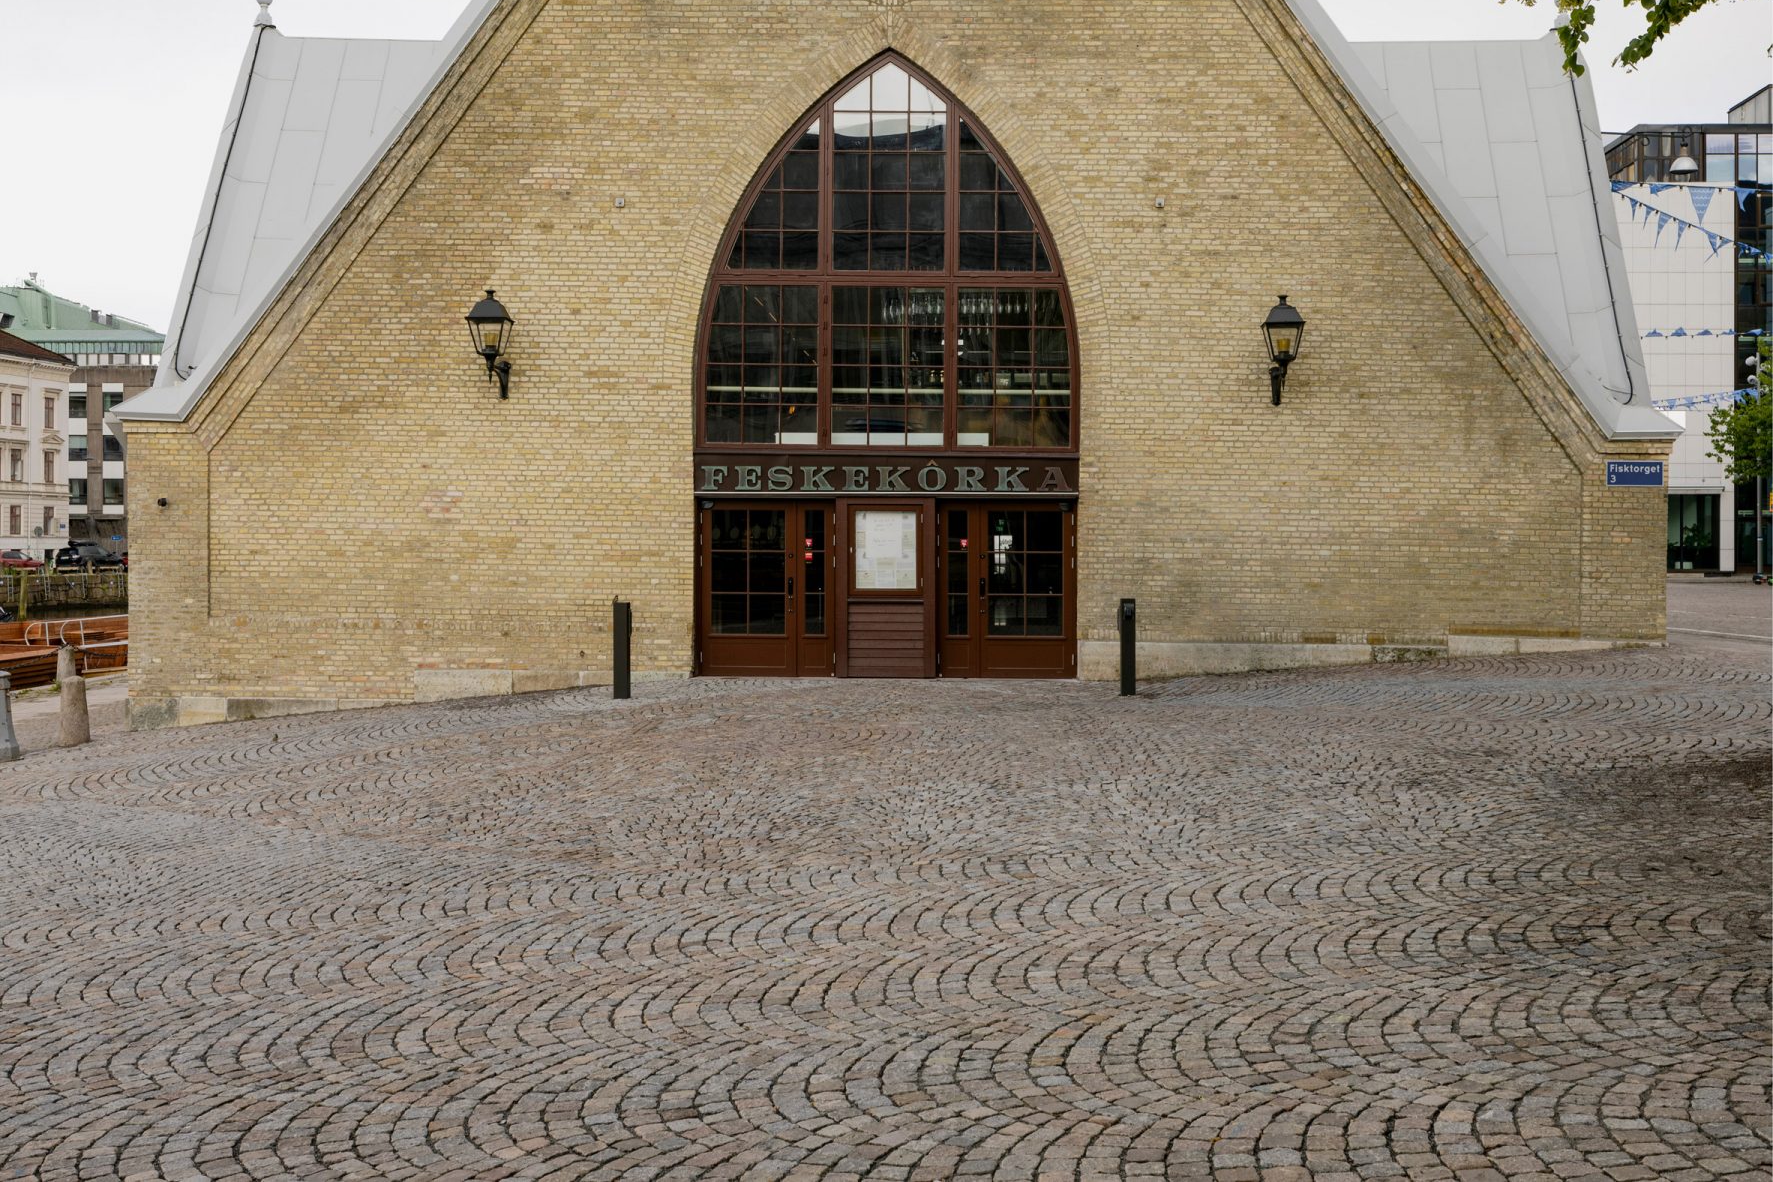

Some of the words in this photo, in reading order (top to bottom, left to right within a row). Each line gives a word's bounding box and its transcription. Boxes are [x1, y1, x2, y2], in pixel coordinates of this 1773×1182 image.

[701, 459, 1072, 491] FESKEKÔRKA
[1610, 464, 1660, 475] Fisktorget
[1610, 474, 1617, 483] 3
